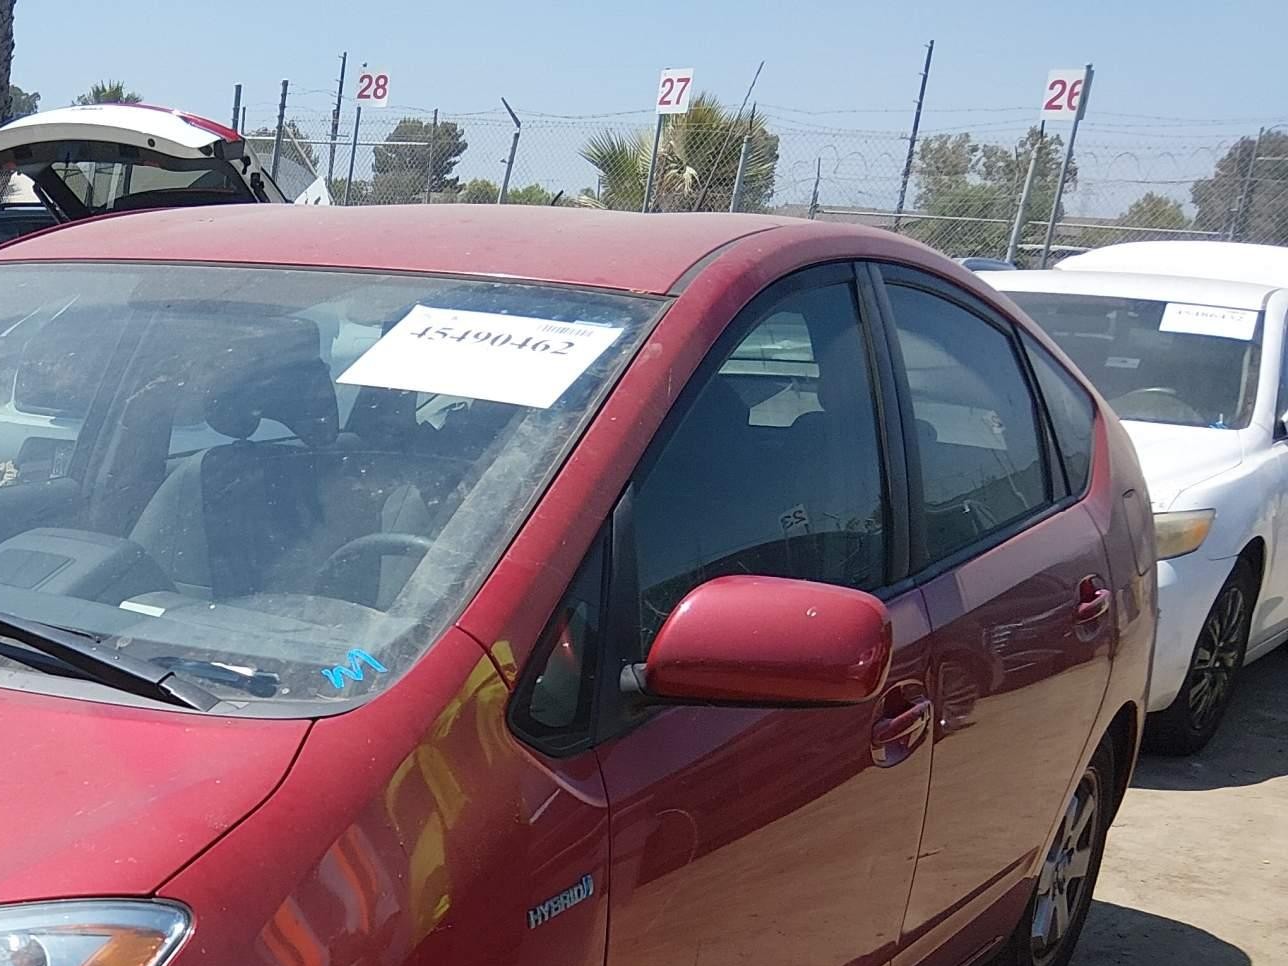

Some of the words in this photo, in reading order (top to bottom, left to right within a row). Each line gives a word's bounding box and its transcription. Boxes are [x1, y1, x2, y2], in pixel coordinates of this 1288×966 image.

[357, 74, 388, 99] 28
[658, 77, 691, 105] 27
[410, 326, 575, 355] 45490462
[528, 884, 585, 929] HYBRID
